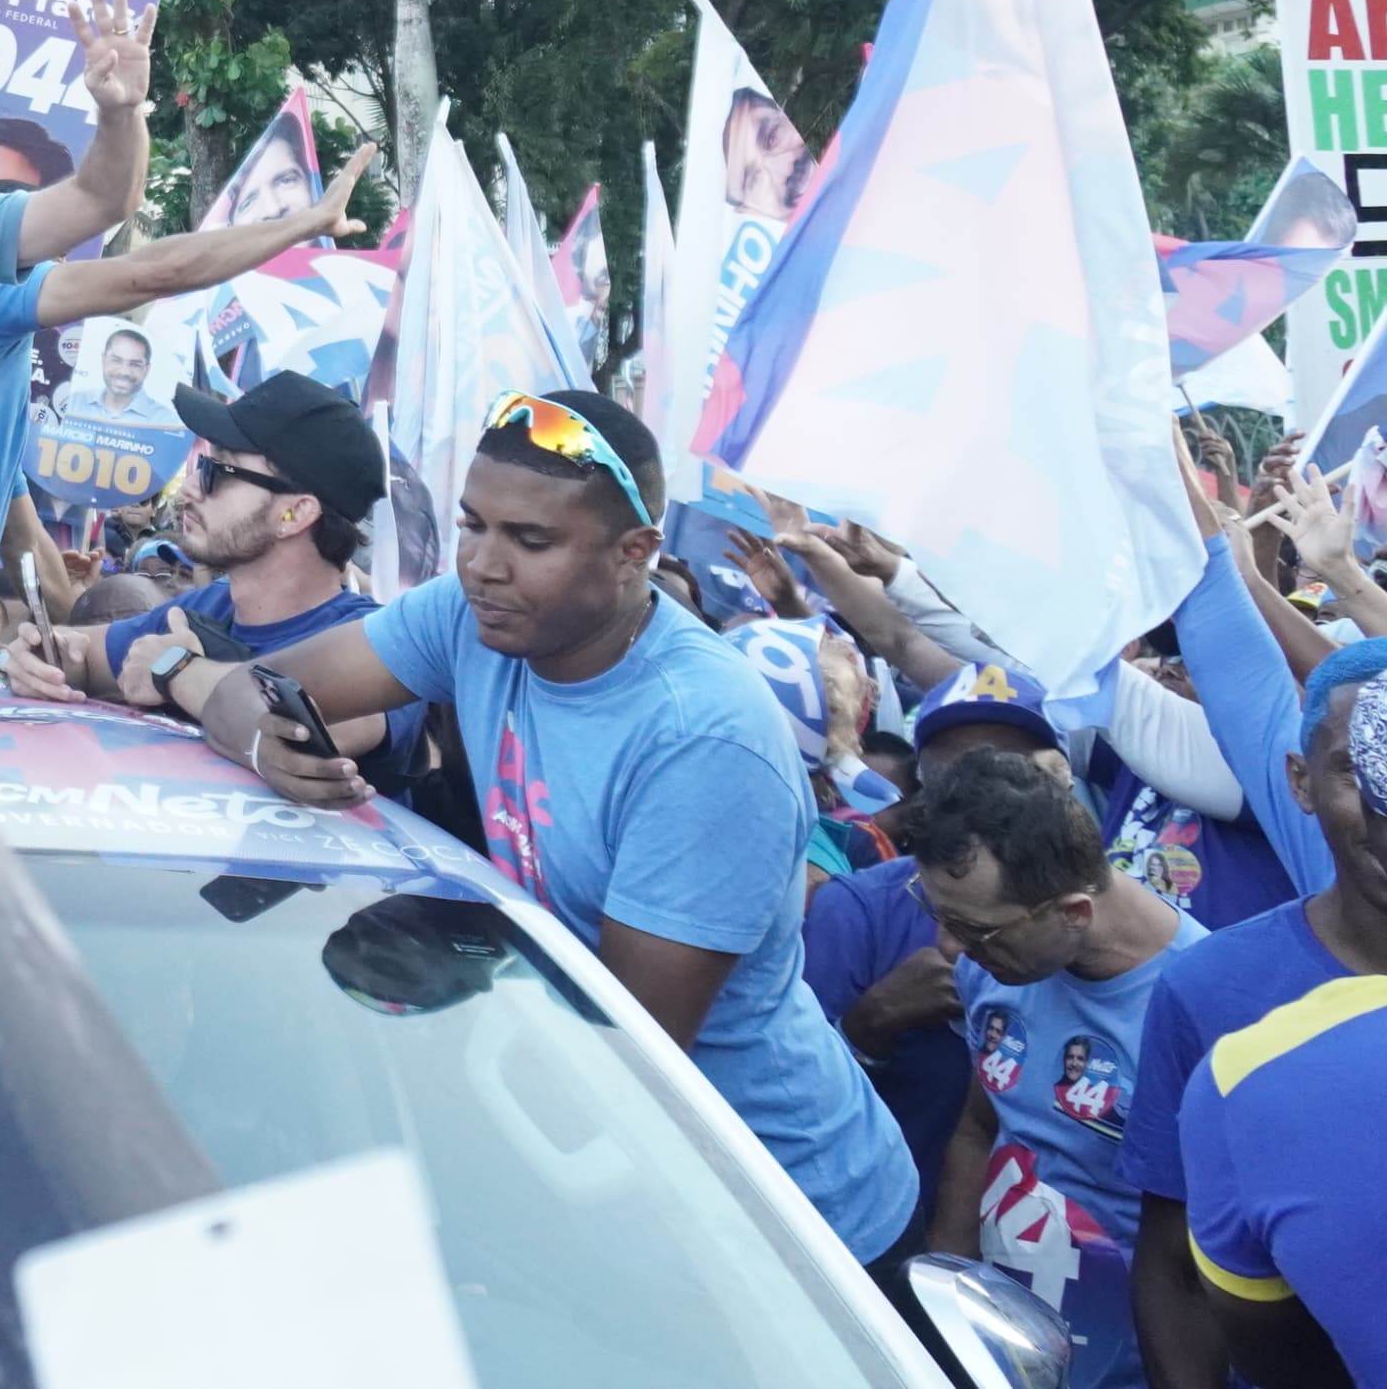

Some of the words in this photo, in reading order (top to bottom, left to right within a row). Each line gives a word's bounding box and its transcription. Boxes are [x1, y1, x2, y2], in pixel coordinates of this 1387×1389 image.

[5, 10, 59, 30] FEDERAL
[96, 435, 154, 455] MARINHO
[38, 438, 152, 496] 1010
[87, 783, 343, 829] Neto
[982, 1049, 1017, 1091] 44
[1066, 1076, 1109, 1117] 44
